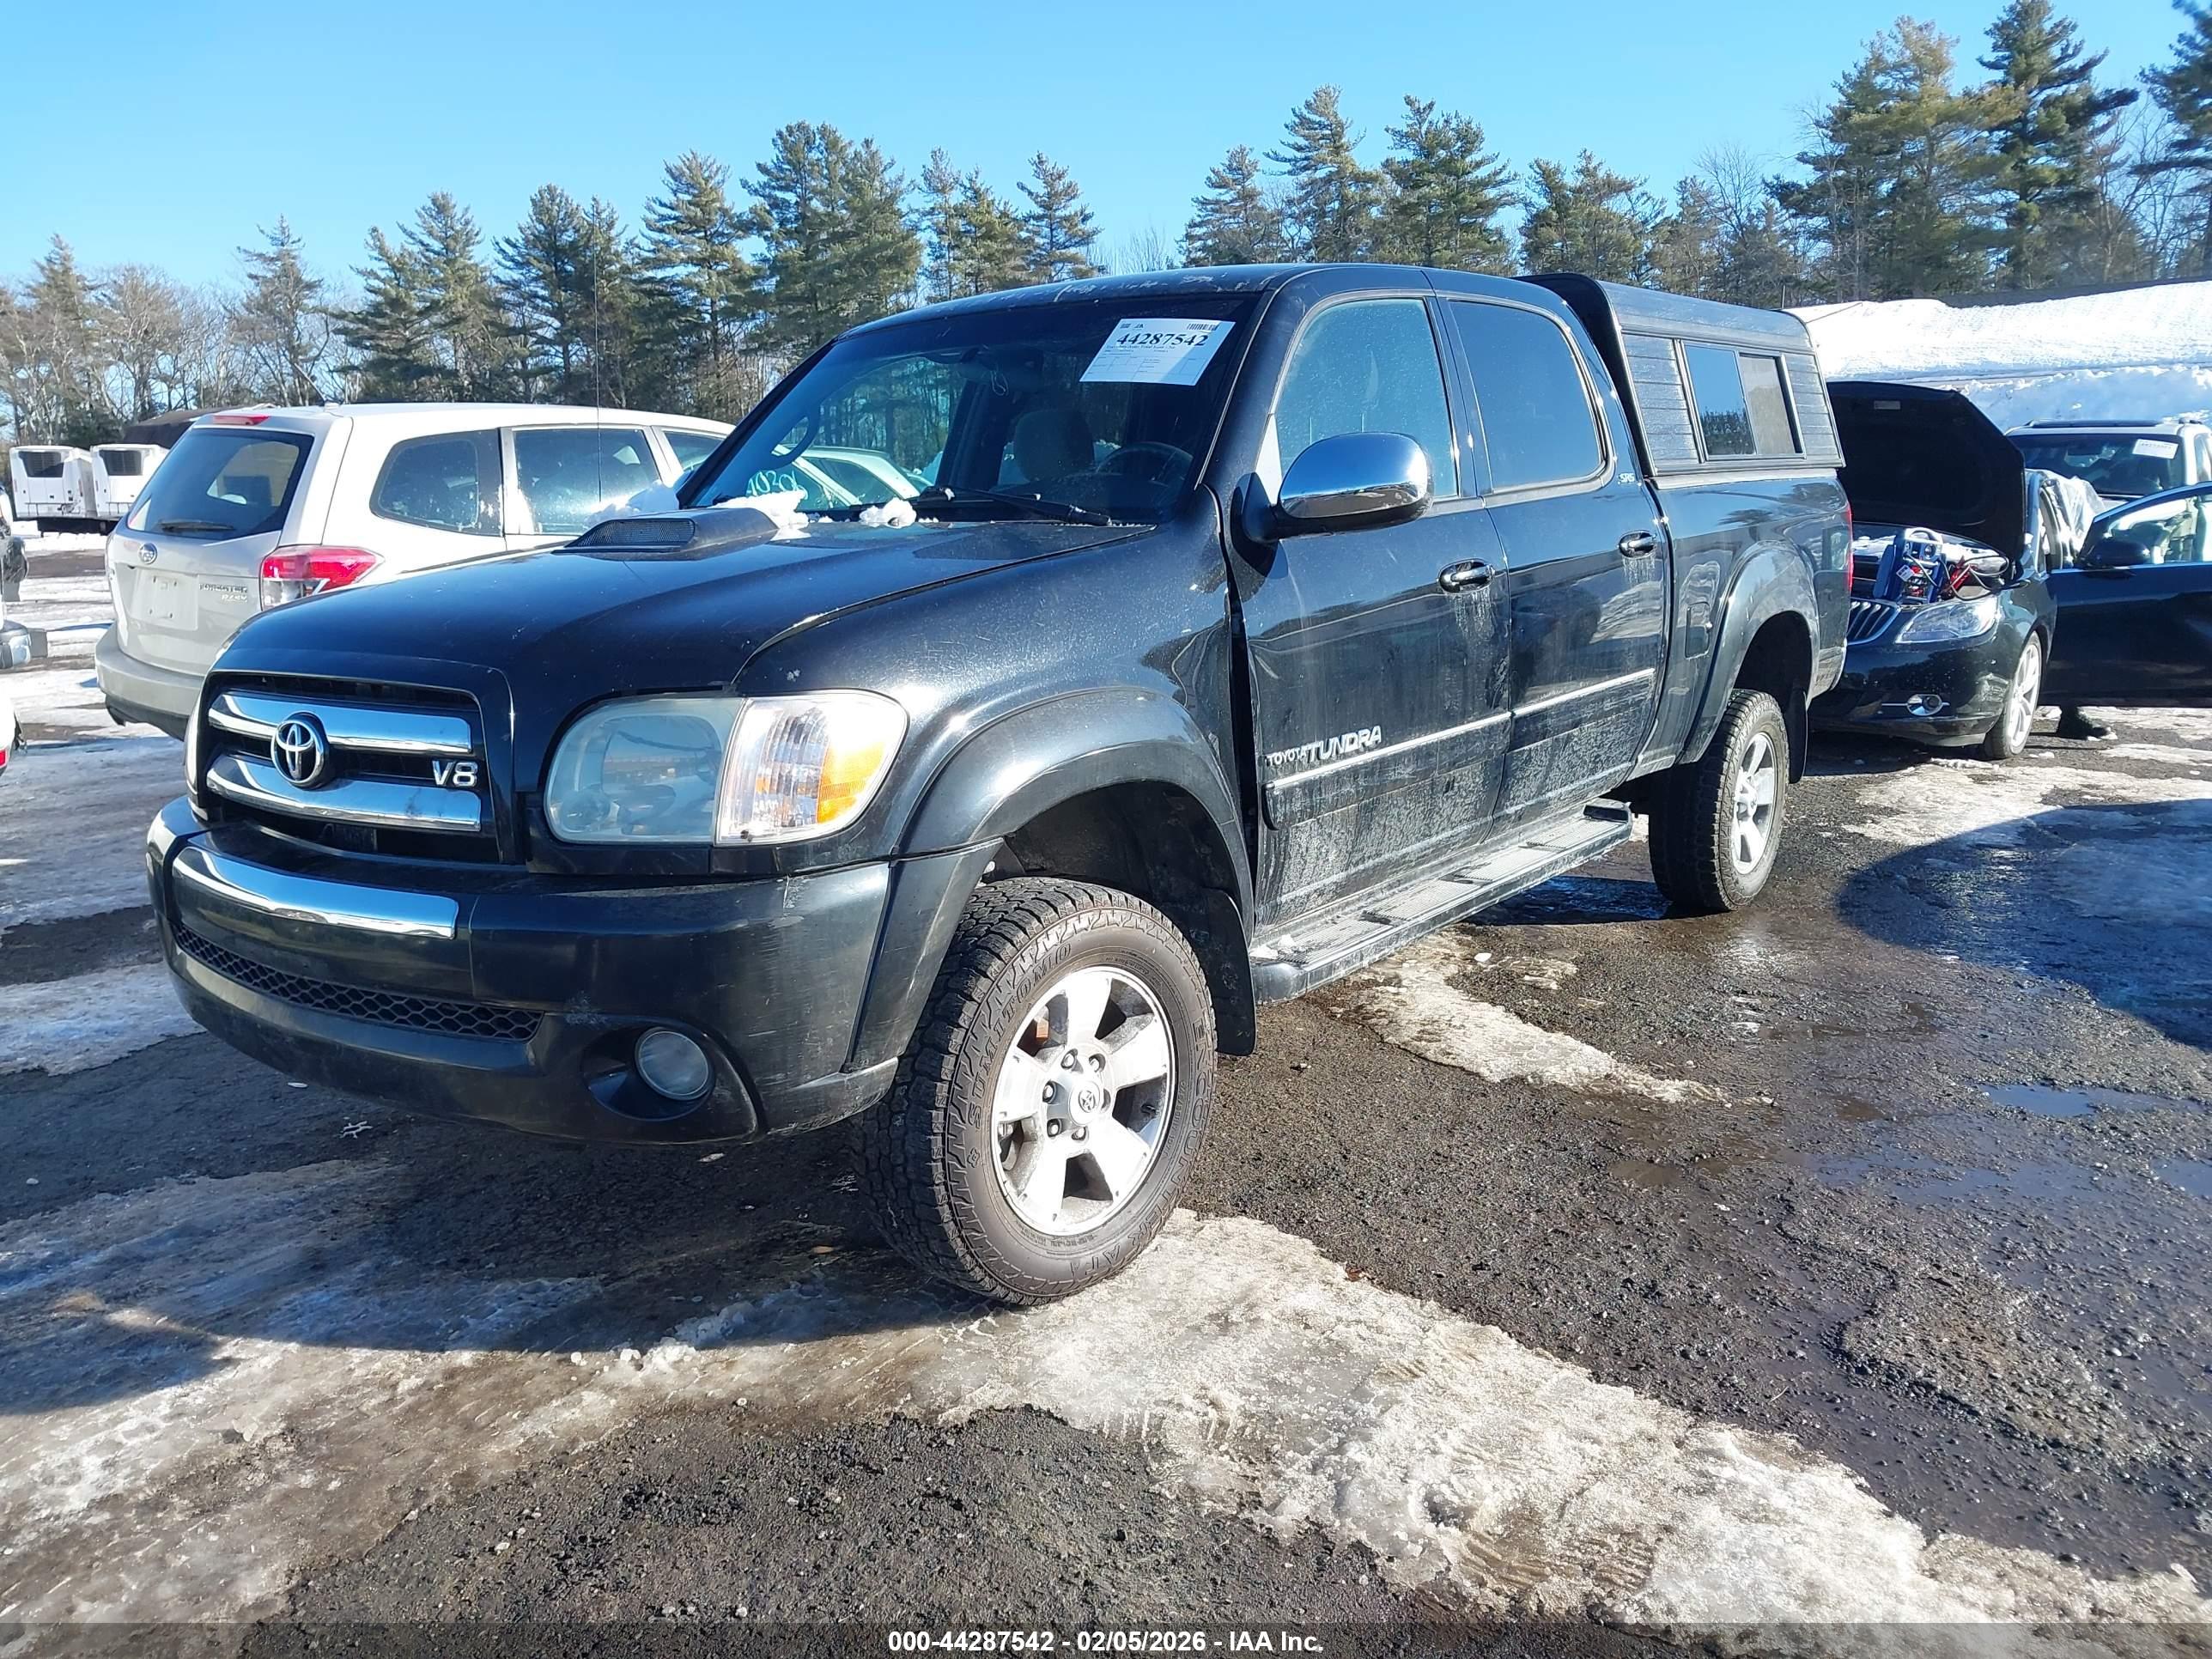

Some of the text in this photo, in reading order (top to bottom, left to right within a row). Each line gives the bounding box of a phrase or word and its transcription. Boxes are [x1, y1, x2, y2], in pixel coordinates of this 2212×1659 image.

[1116, 332, 1209, 346] 44287542
[1266, 725, 1382, 767] TOYOTA TUNDRA
[432, 760, 478, 787] V8
[968, 943, 1072, 1129] SUMITOMO
[1127, 1018, 1207, 1247] ENCOUNTER
